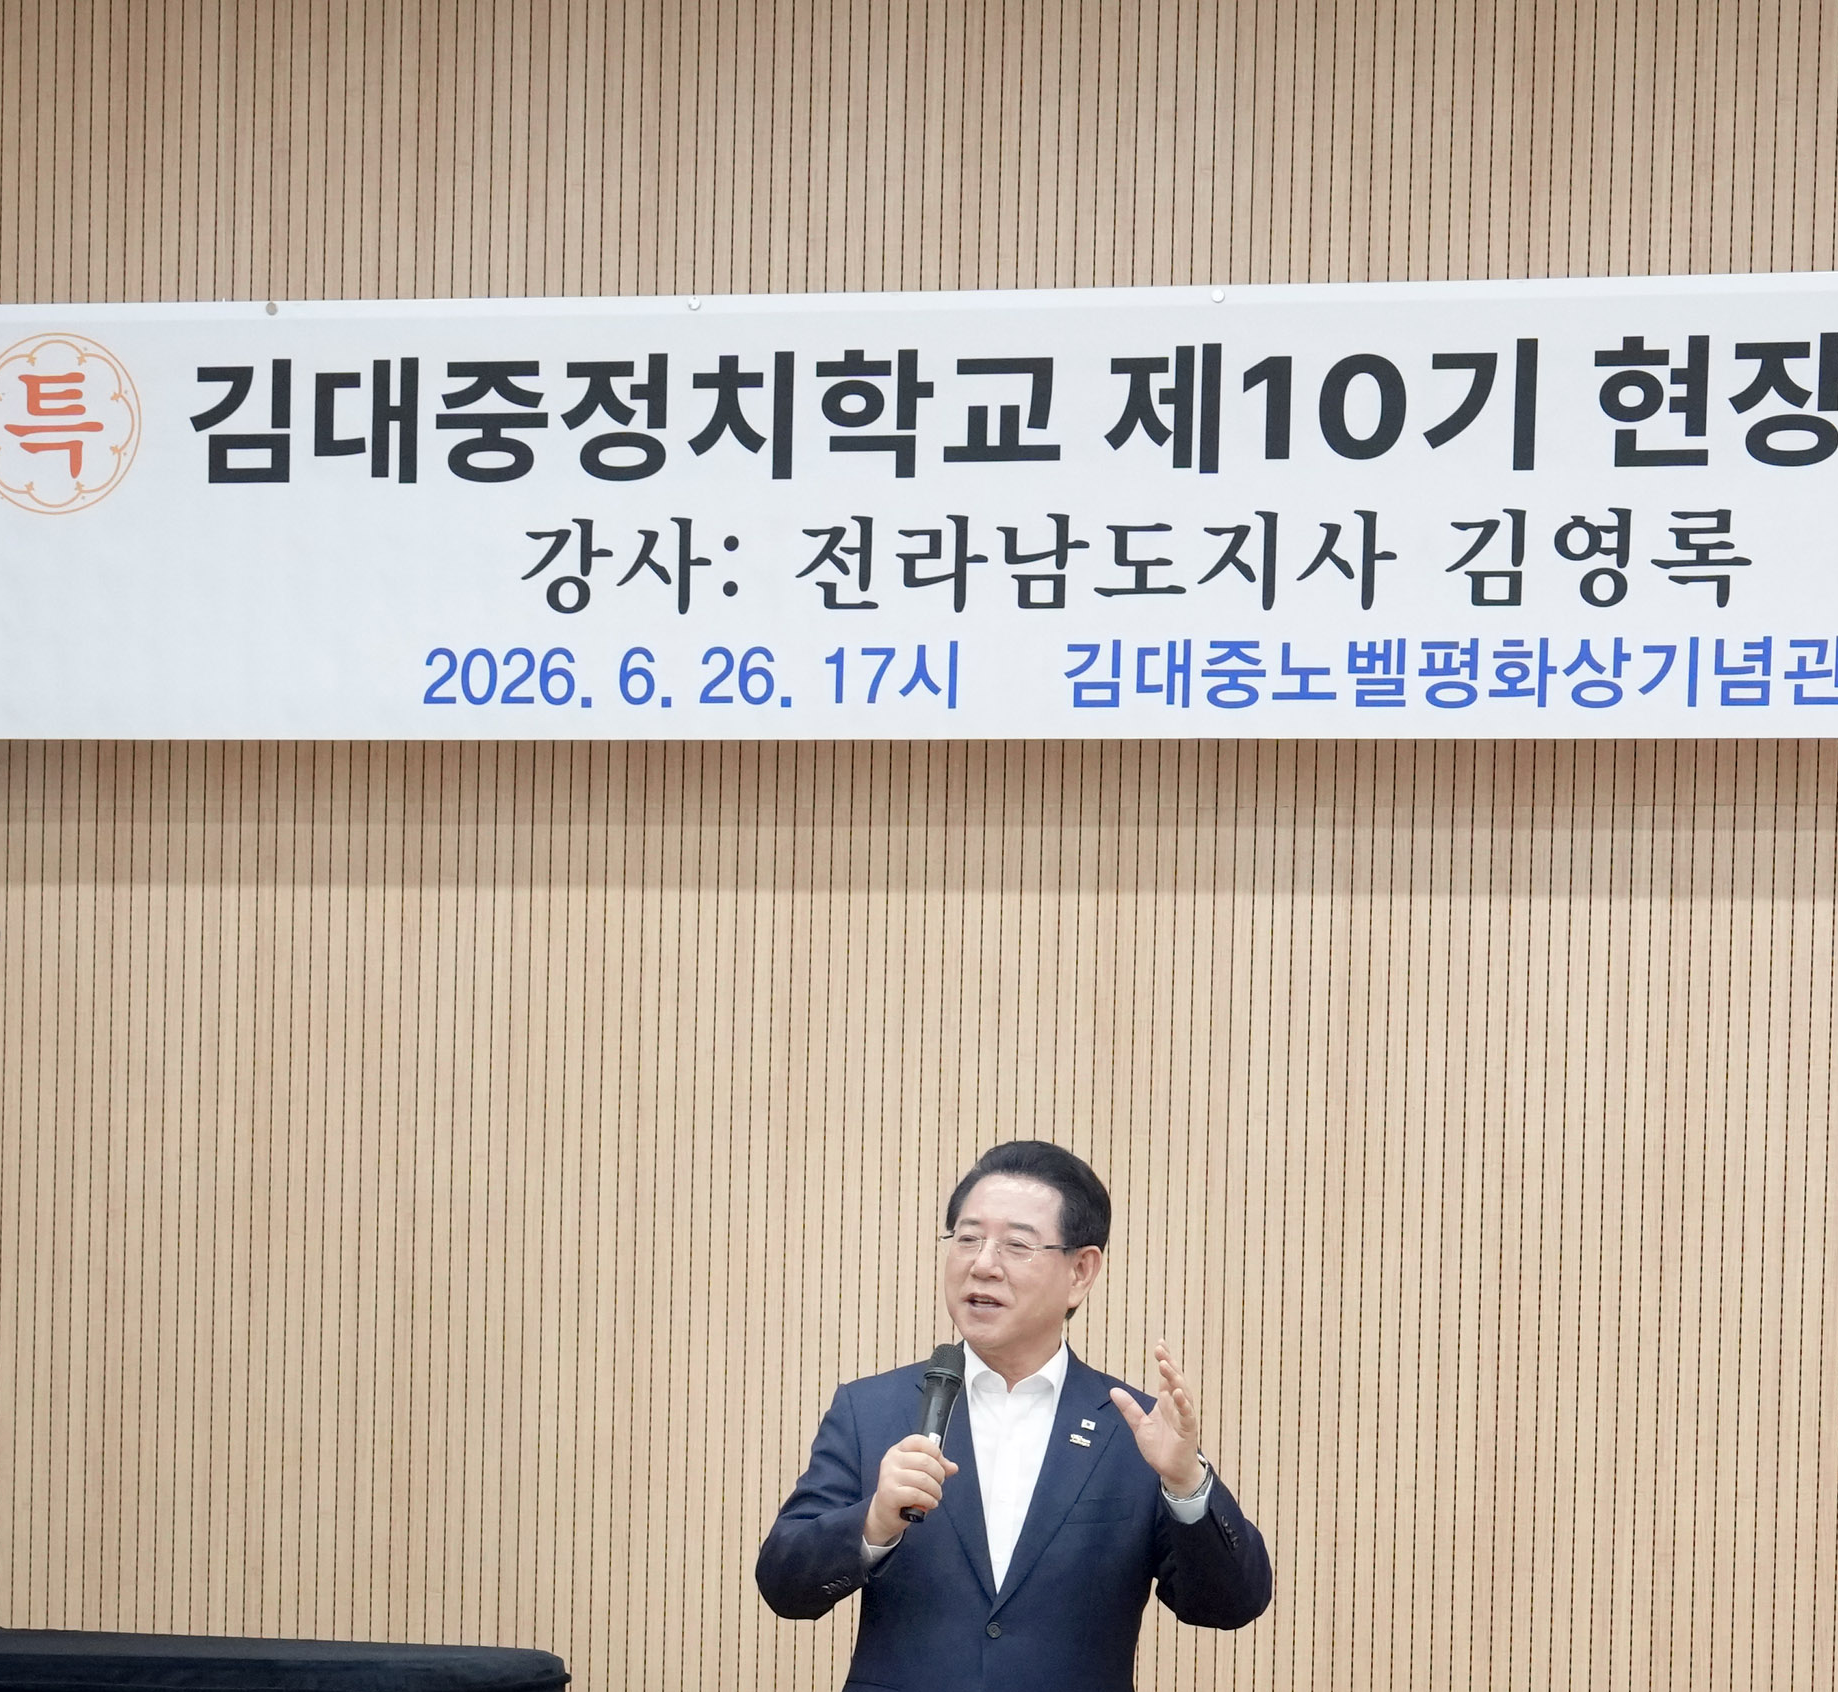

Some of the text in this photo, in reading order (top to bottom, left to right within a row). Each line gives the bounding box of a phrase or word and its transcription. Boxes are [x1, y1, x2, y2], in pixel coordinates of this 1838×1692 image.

[4, 371, 105, 479] 특
[188, 347, 1062, 485] 김대중정치학교
[1103, 336, 1540, 475] 제10기
[520, 506, 1754, 616] 강사: 전라남도지사 김영록
[421, 645, 594, 710] 2026.
[617, 645, 673, 710] 6.
[697, 644, 794, 710] 26.
[823, 639, 960, 711] 17시
